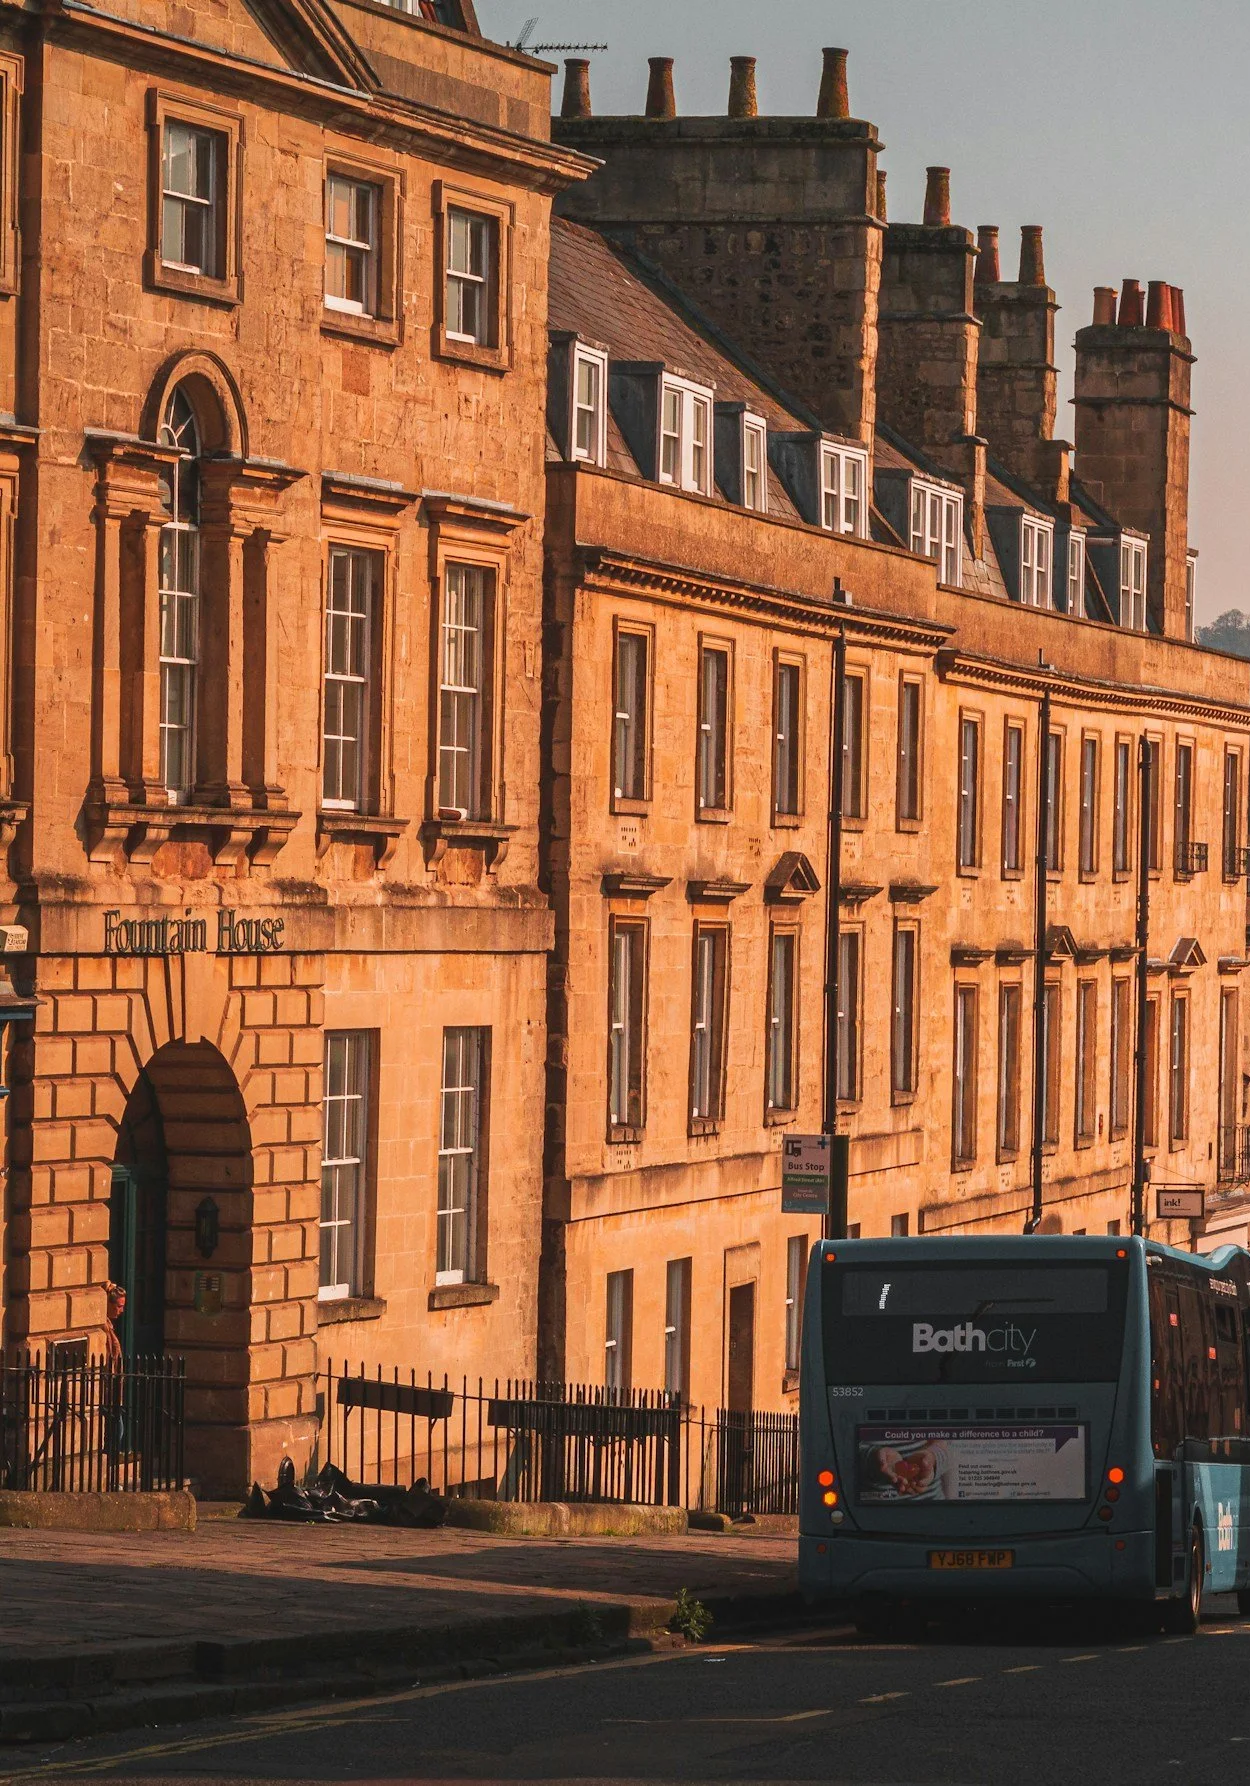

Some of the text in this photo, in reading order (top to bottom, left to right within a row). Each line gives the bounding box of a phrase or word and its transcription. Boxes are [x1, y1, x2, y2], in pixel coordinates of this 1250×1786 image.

[102, 907, 285, 952] Fountain House
[788, 1162, 825, 1172] Bus Stop
[1164, 1198, 1181, 1207] ink!
[1007, 1359, 1024, 1367] First
[832, 1387, 864, 1397] 53852
[885, 1431, 909, 1439] Could
[960, 1430, 1000, 1438] difference
[937, 1551, 1005, 1566] YJ68 FWP
